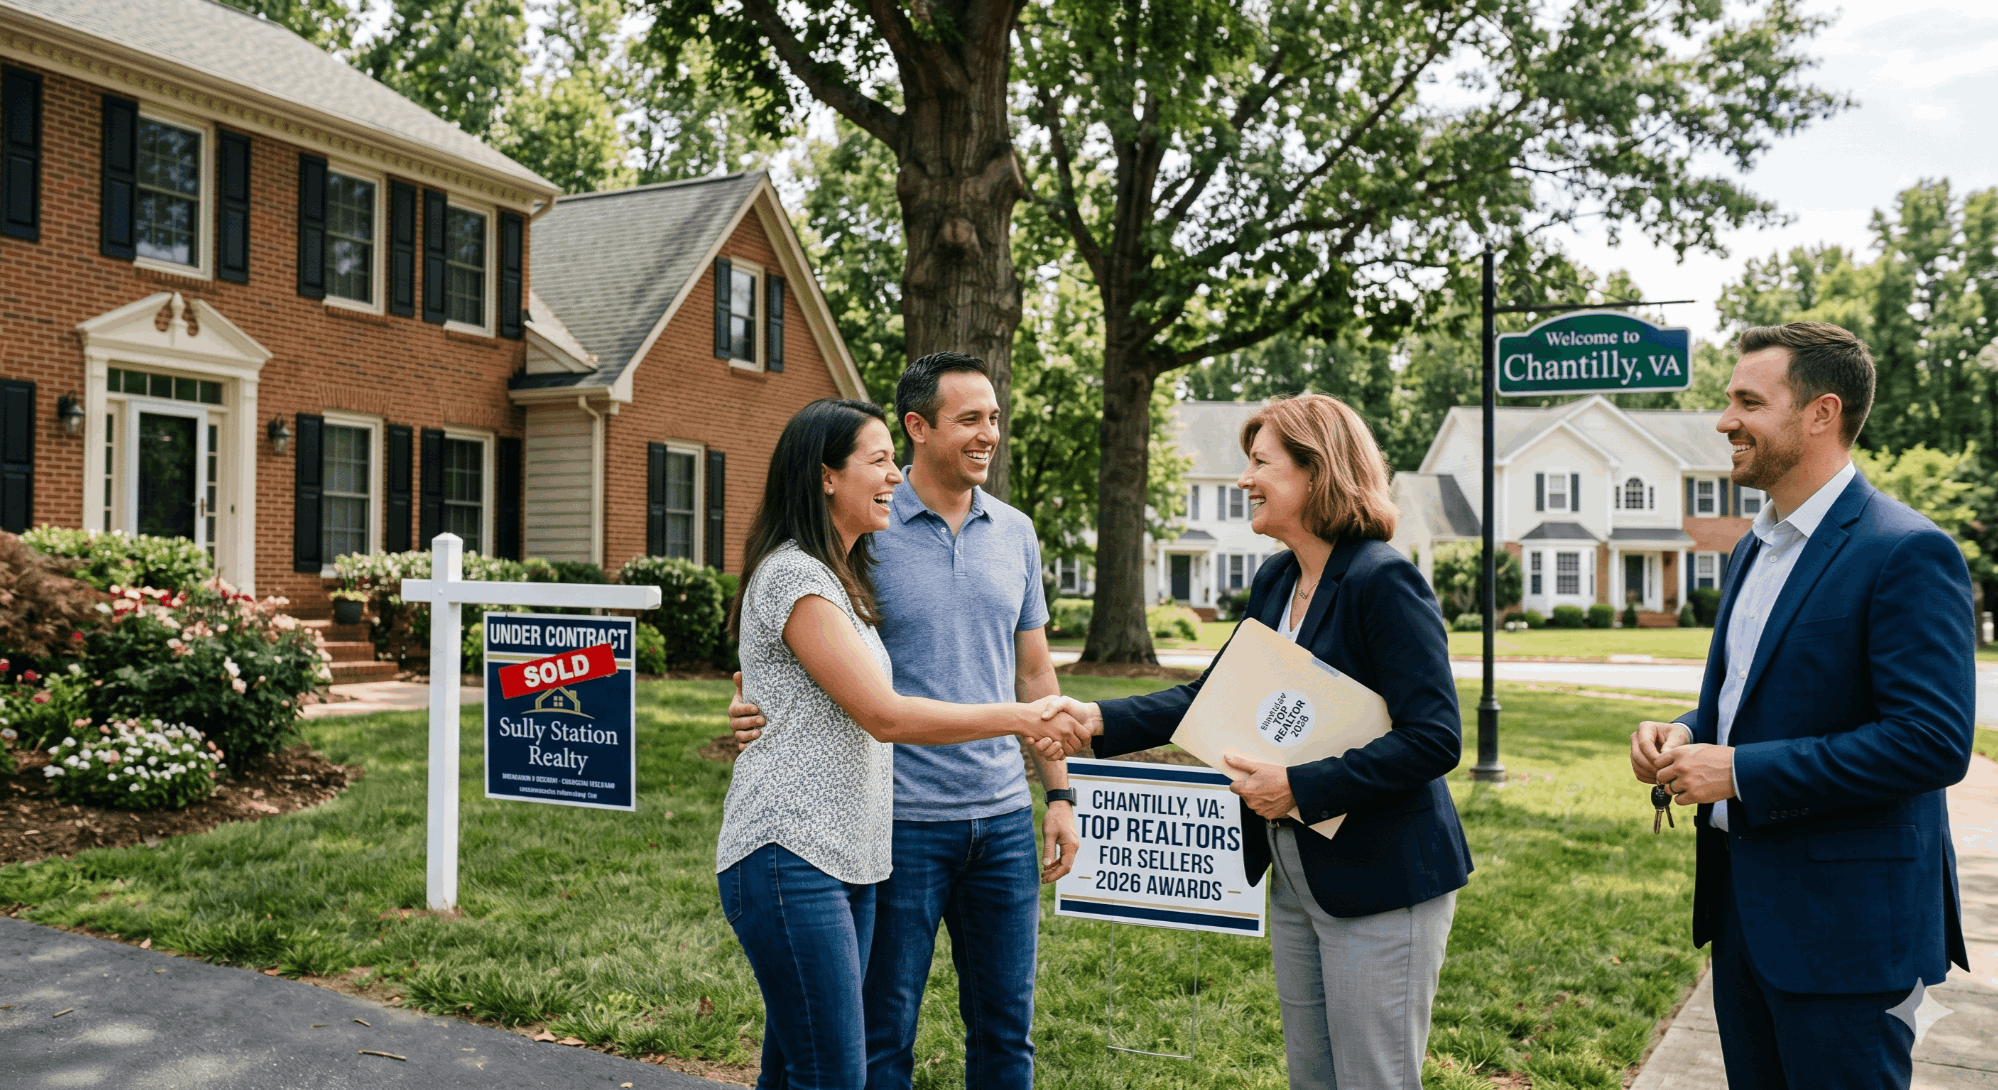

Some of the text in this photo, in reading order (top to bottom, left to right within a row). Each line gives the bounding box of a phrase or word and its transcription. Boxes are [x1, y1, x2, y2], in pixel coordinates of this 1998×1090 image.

[1545, 330, 1640, 346] Welcome to
[1503, 349, 1682, 386] Chantilly, VA
[490, 623, 628, 650] UNDER CONTRACT
[523, 654, 590, 688] SOLD
[1272, 705, 1288, 725] TOP
[1274, 699, 1306, 743] REALTOR
[499, 716, 619, 746] Sully Station
[528, 745, 589, 776] Realty
[1092, 789, 1225, 820] CHANTILLY, VA:
[1077, 813, 1241, 852] TOP REALTORS
[1099, 845, 1214, 875] FOR SELLERS
[1095, 870, 1223, 902] 2026 AWARDS
